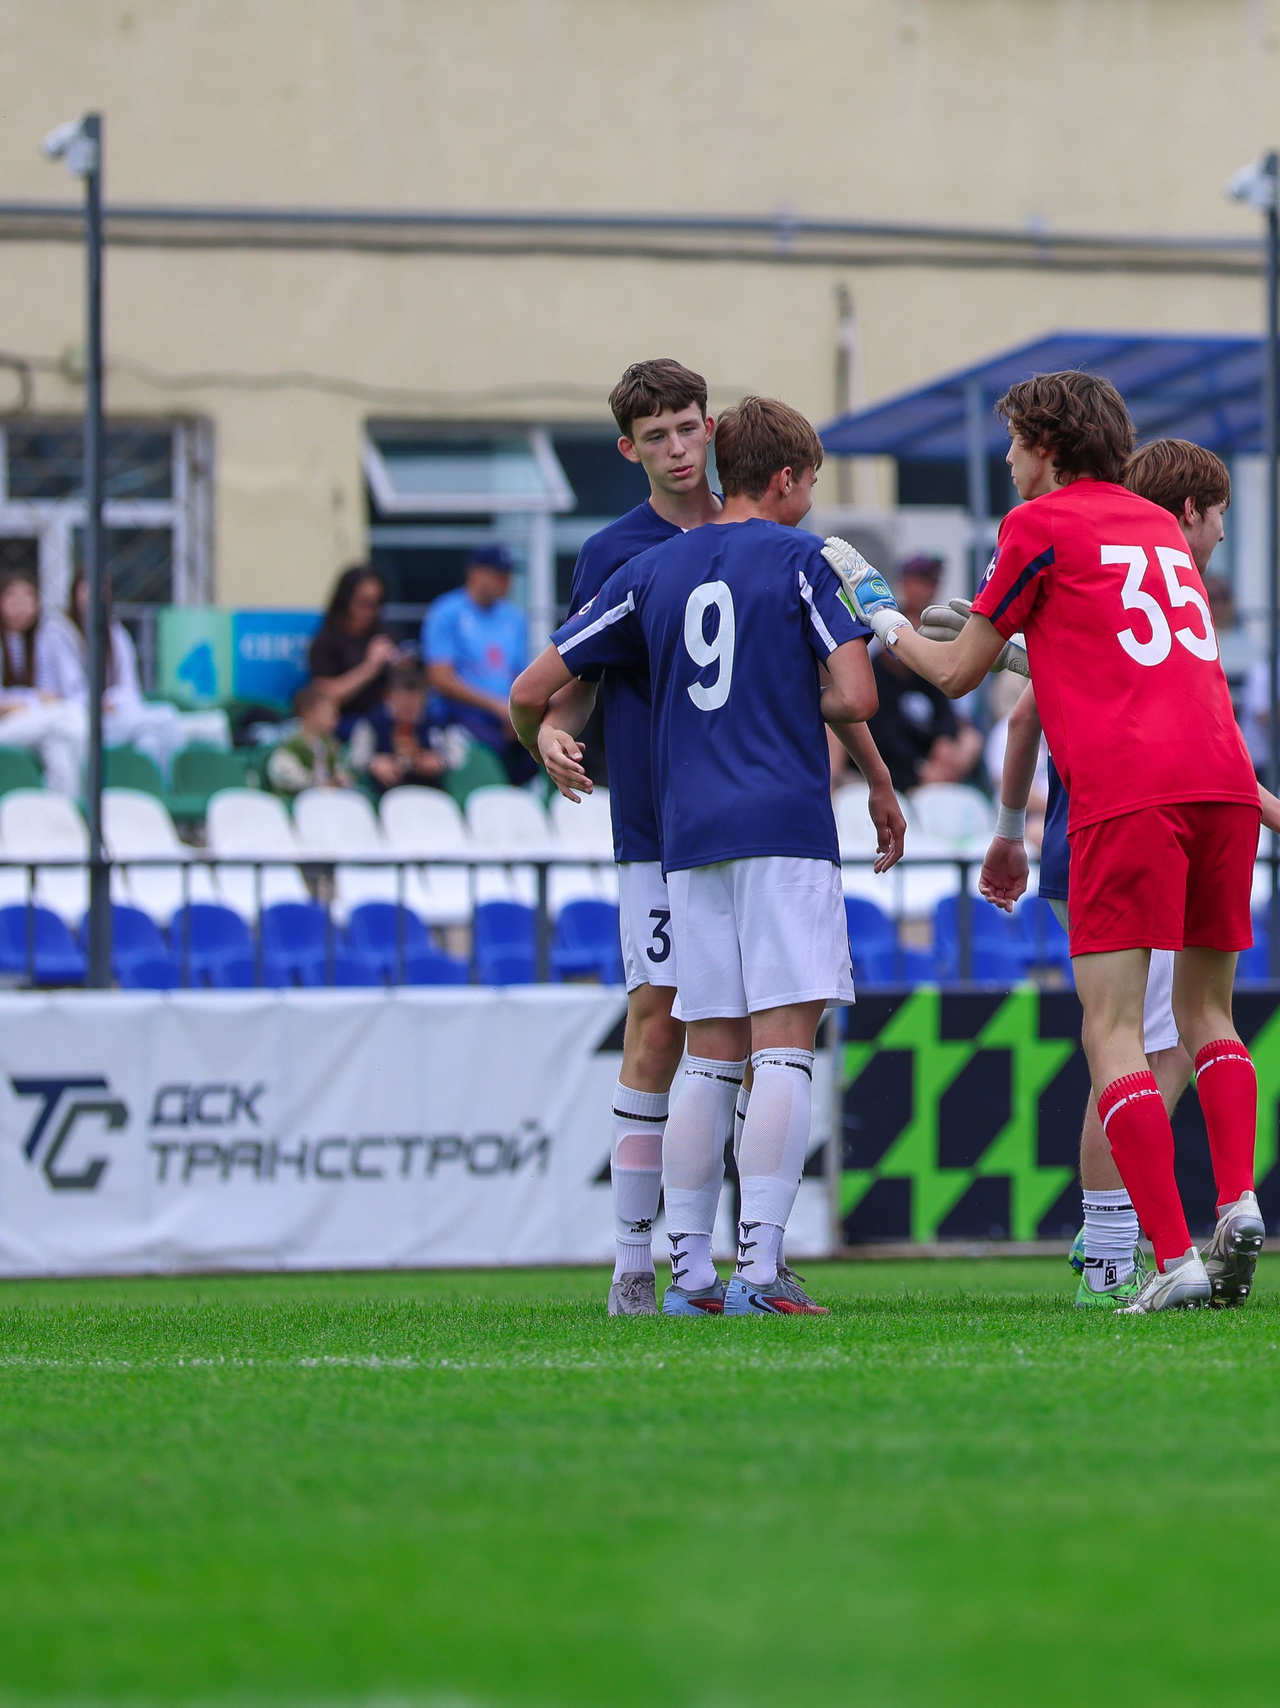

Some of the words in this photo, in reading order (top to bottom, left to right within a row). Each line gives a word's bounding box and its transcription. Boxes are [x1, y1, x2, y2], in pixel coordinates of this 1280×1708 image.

[1100, 544, 1219, 667] 35
[684, 580, 735, 711] 9
[646, 908, 671, 964] 3
[1216, 1053, 1255, 1069] KELM
[149, 1082, 267, 1127] ДСК
[1128, 1088, 1162, 1101] KELM
[150, 1117, 552, 1182] ТРАНССТРОЙ
